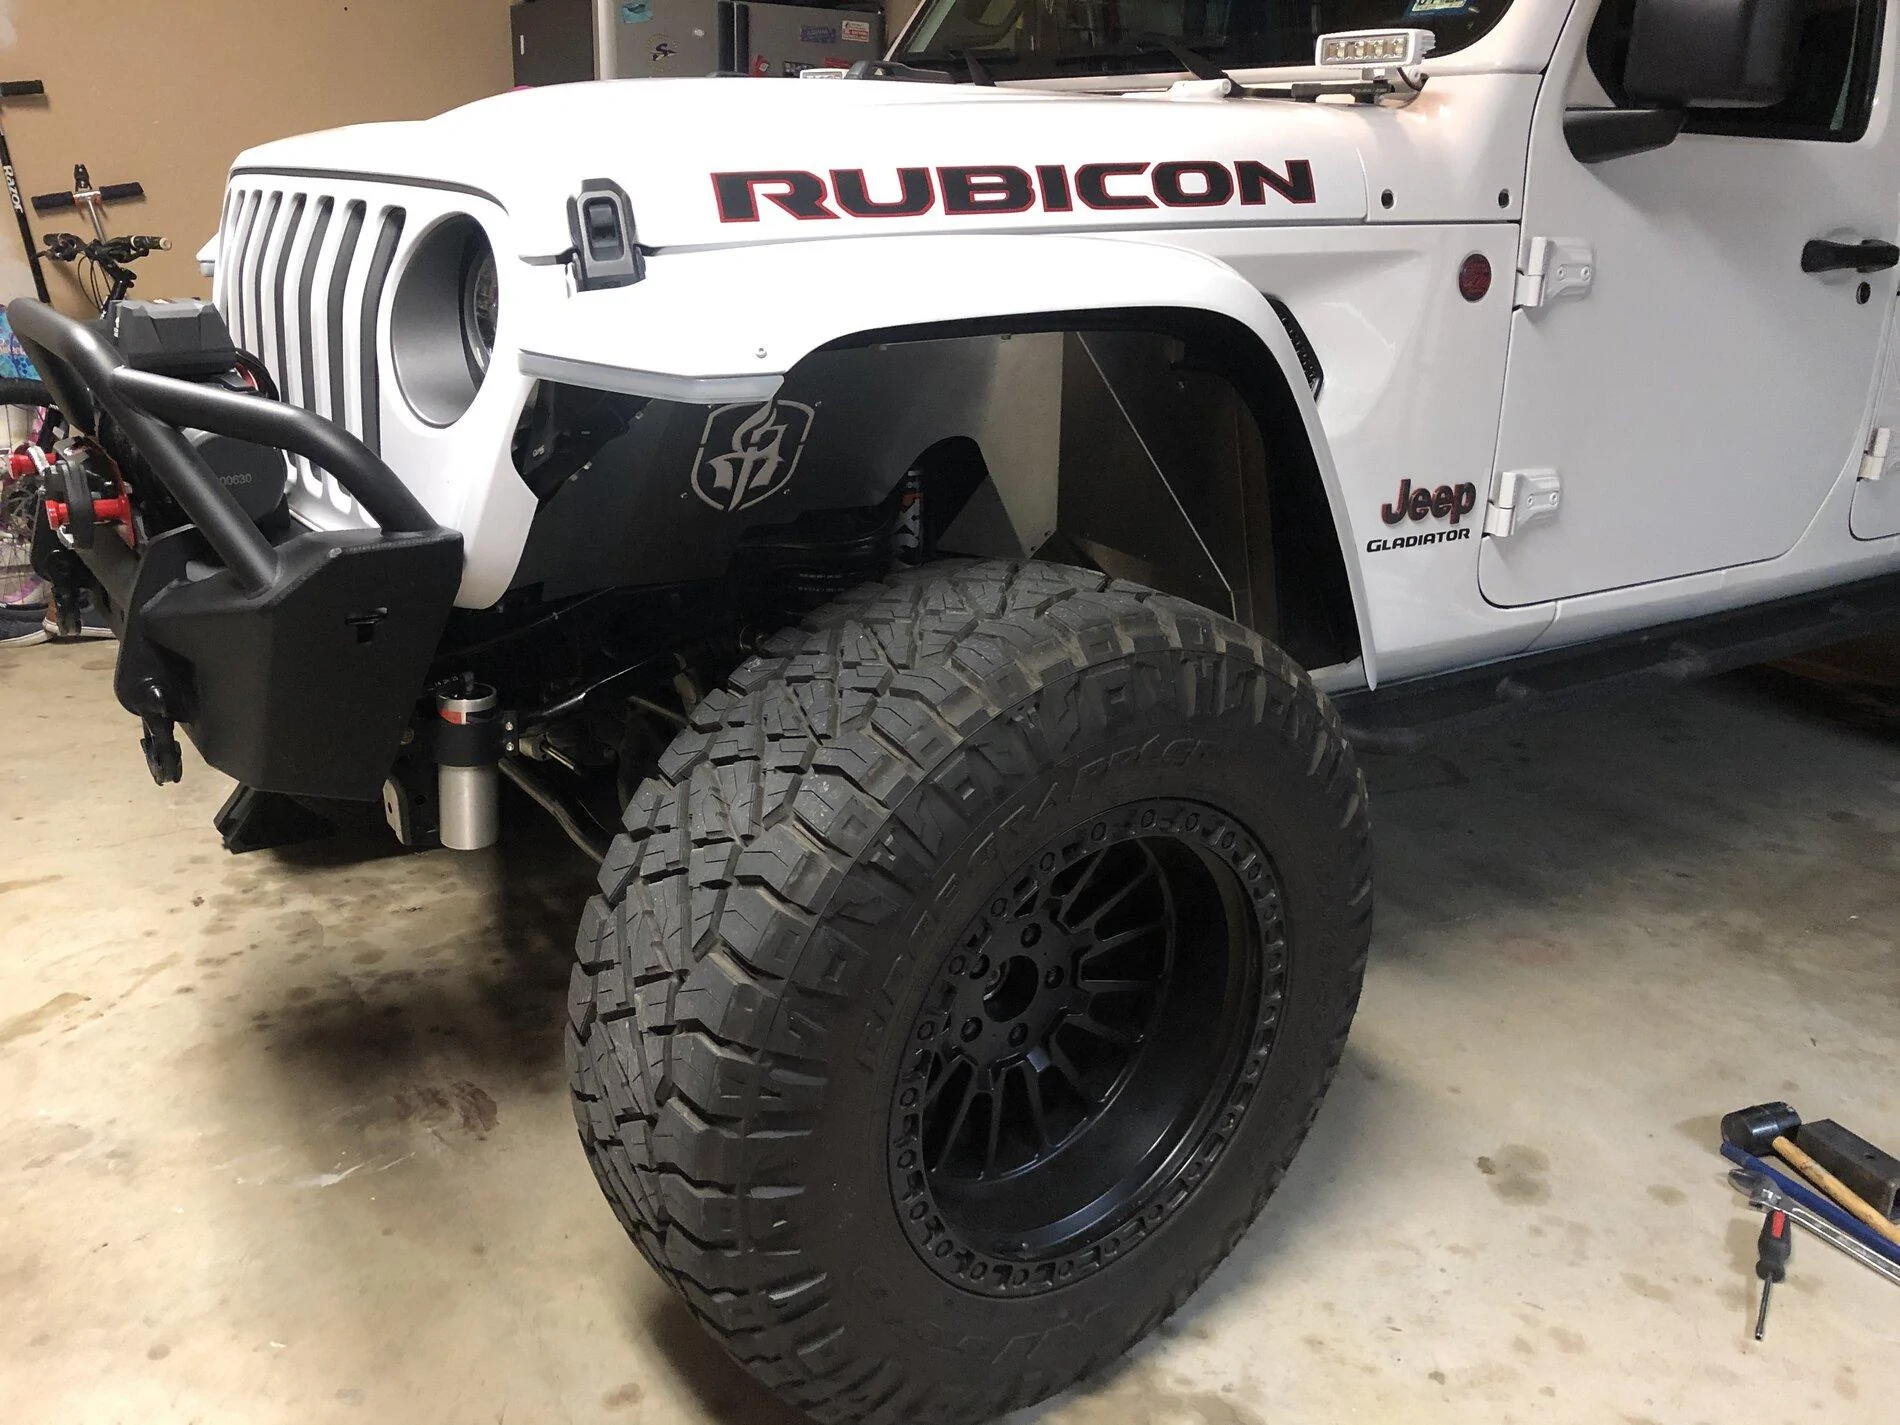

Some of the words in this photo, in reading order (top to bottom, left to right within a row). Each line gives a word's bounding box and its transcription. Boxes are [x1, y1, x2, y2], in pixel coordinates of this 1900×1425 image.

[3, 165, 23, 213] Razor
[709, 158, 1317, 223] RUBICON
[1381, 478, 1477, 525] Jeep
[1366, 528, 1471, 553] GLADIATOR
